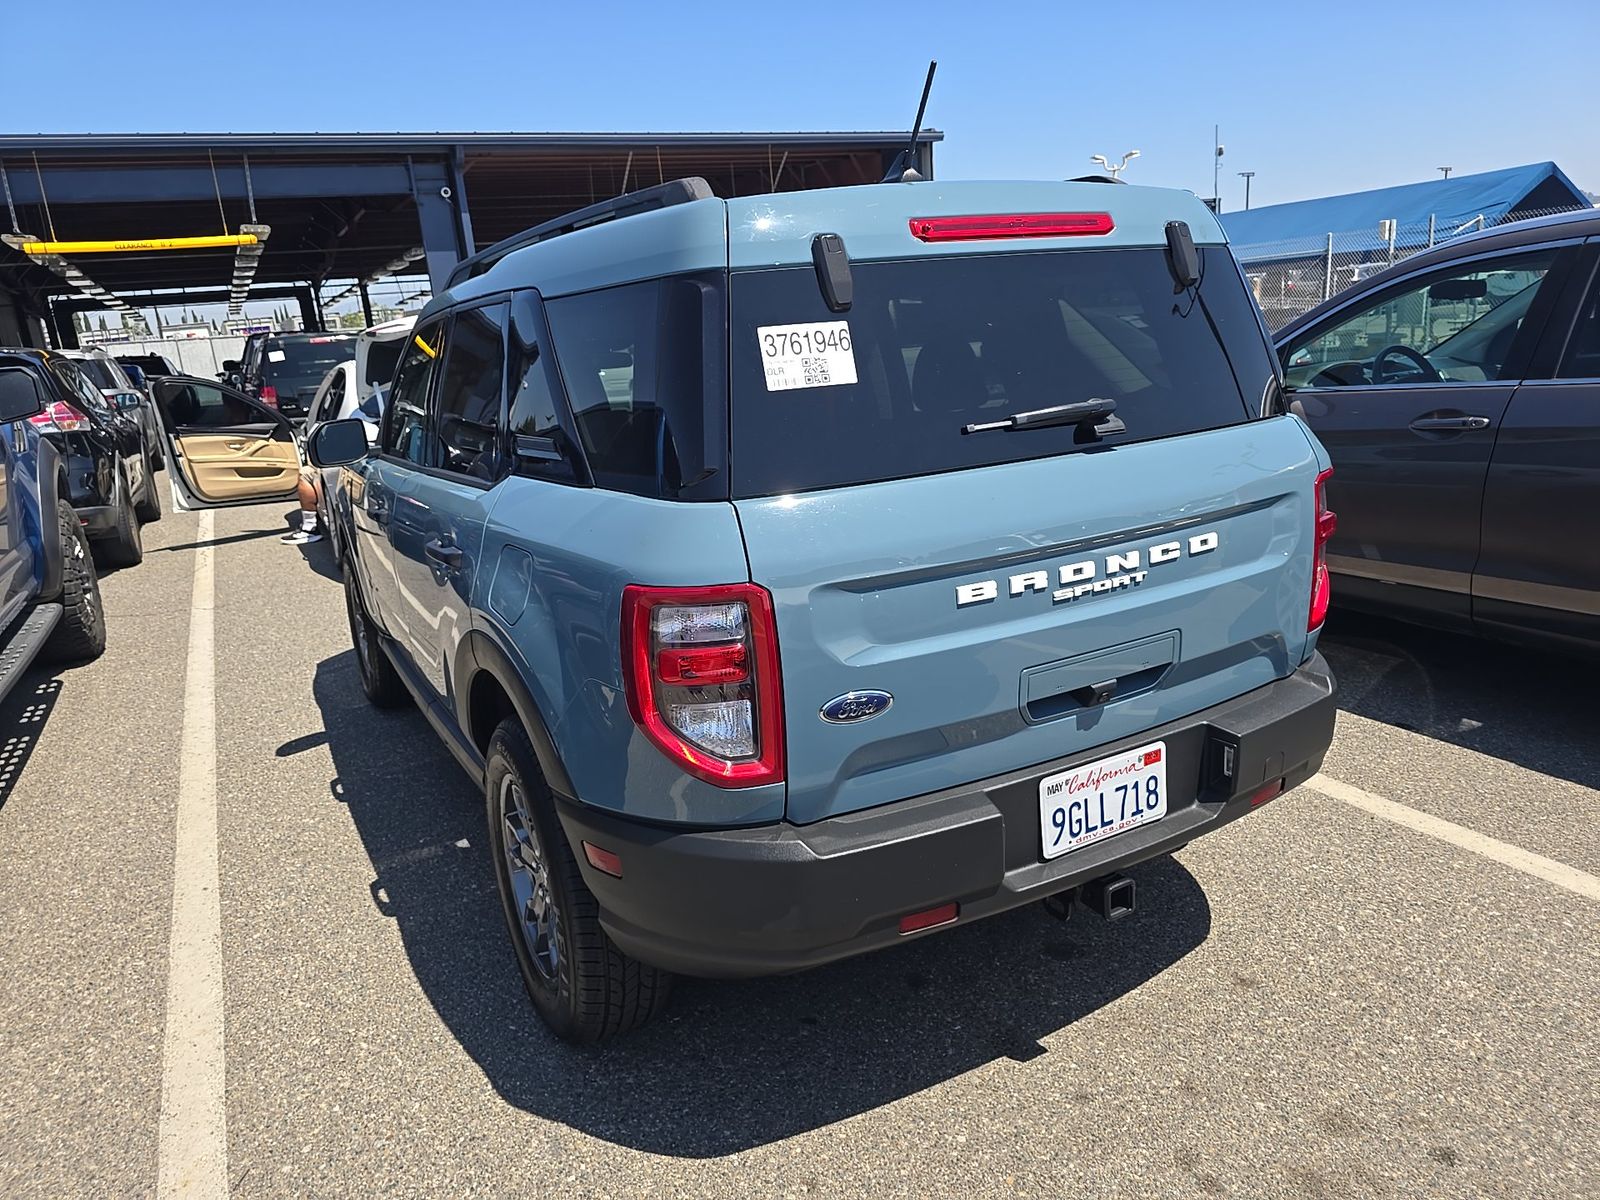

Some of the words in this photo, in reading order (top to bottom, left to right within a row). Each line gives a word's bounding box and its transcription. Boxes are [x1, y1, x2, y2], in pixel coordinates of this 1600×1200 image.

[764, 328, 851, 357] 3761946
[955, 532, 1219, 609] BRONCO
[1052, 570, 1148, 606] SPORT
[838, 696, 878, 719] Ford
[1046, 781, 1064, 797] MAY
[1068, 760, 1145, 795] California
[1052, 775, 1159, 846] 9GLL718
[1075, 817, 1138, 844] dmv.ca.gov
